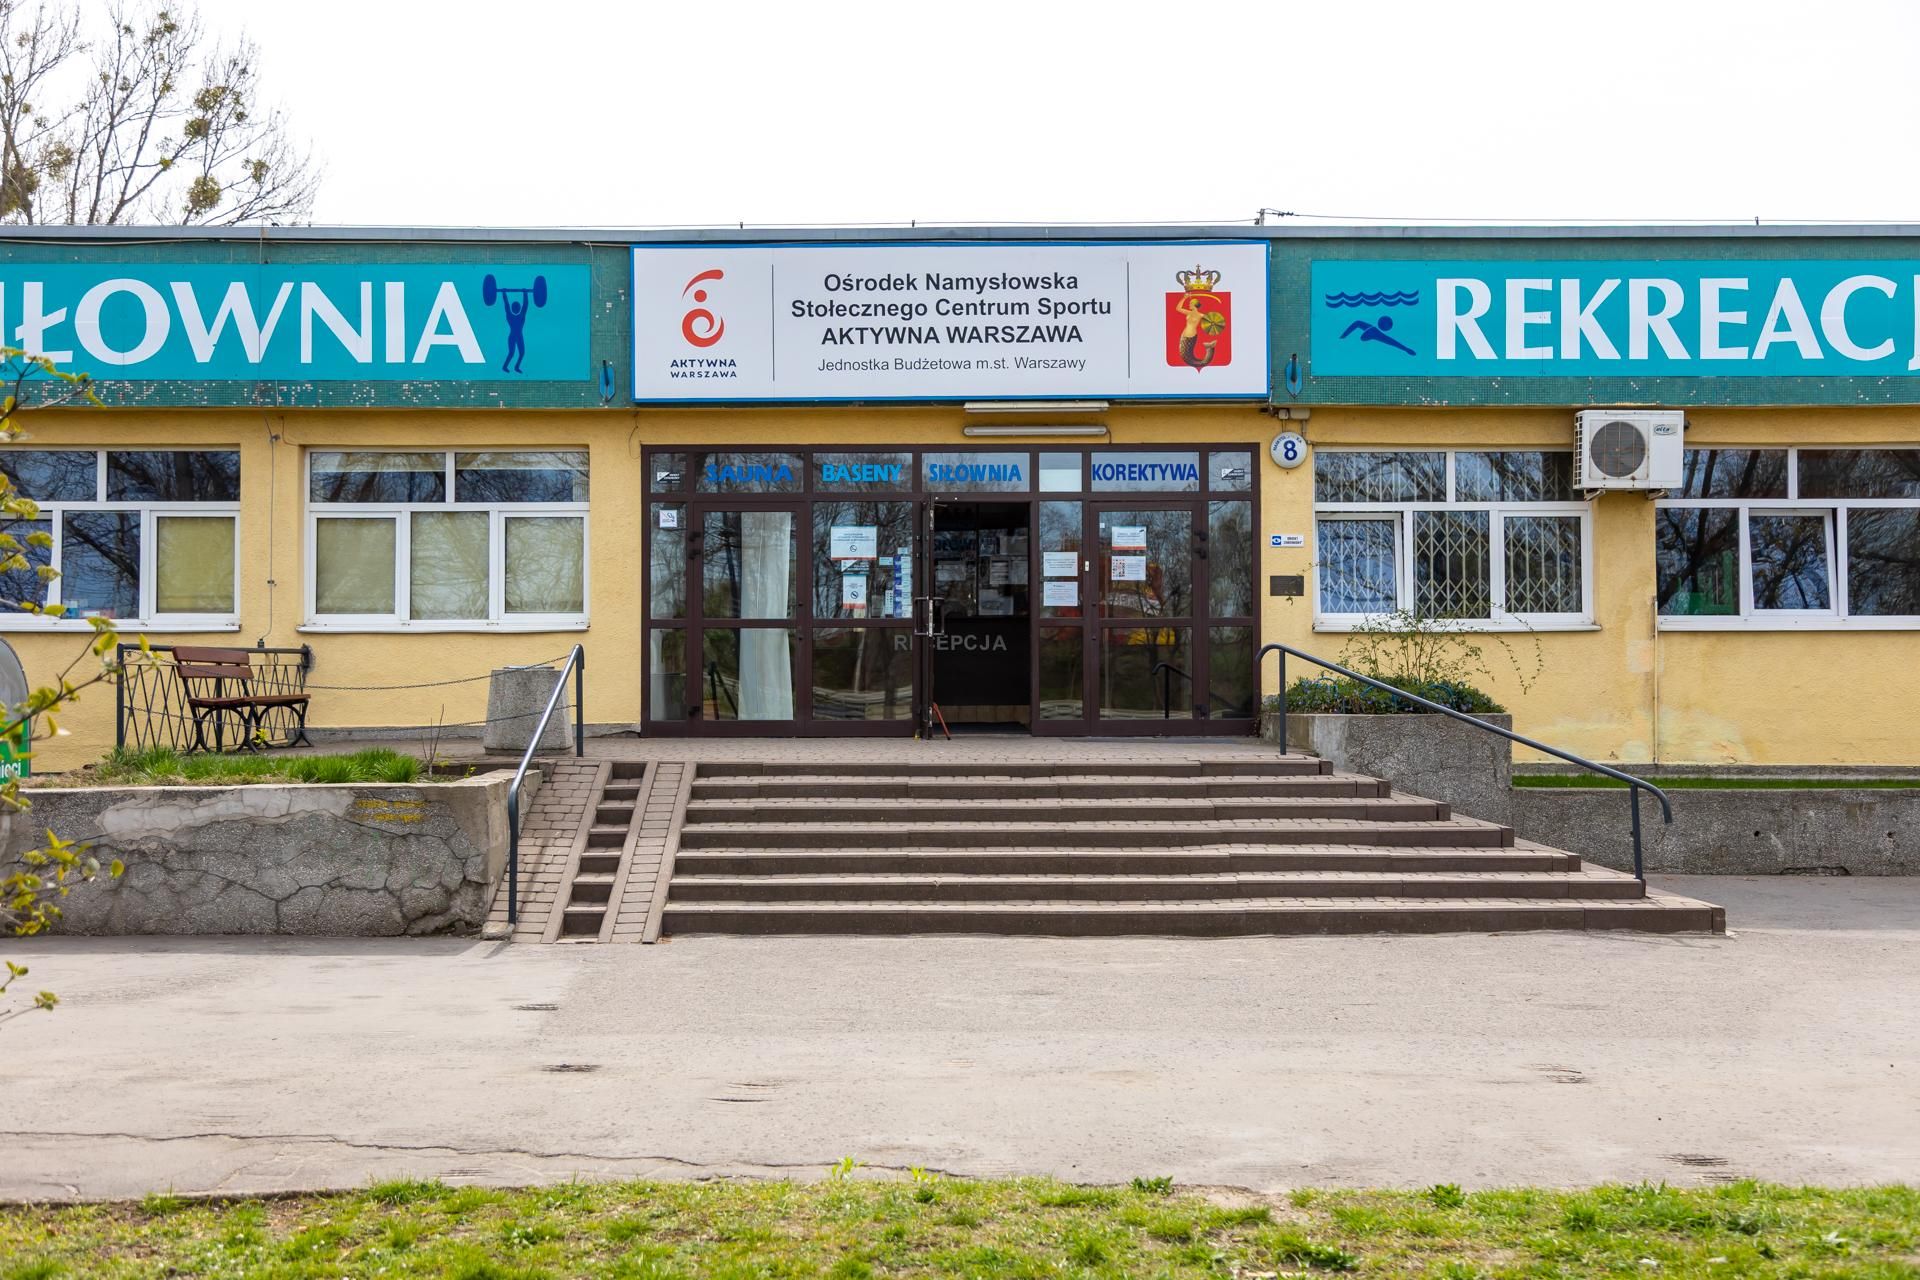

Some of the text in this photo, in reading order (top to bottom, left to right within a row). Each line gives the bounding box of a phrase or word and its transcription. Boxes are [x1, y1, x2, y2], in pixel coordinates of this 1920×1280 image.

[824, 271, 1078, 294] Ośrodek Namysłowska
[791, 297, 1111, 321] Stołecznego Centrum Sportu
[0, 278, 486, 365] ŁOWNIA
[821, 325, 1083, 345] AKTYWNA WARSZAWA
[670, 358, 737, 368] AKTYWNA
[818, 356, 1086, 372] Jednostka Budżetowa m.st. Warszawy
[670, 370, 737, 378] WARSZAWA
[1283, 440, 1298, 461] 8
[705, 463, 793, 482] SAUNA
[822, 463, 903, 482] BASENY
[928, 463, 1023, 482] SIŁOWNIA
[1092, 463, 1199, 481] KOREKTYWA
[894, 634, 1008, 651] REPCJA
